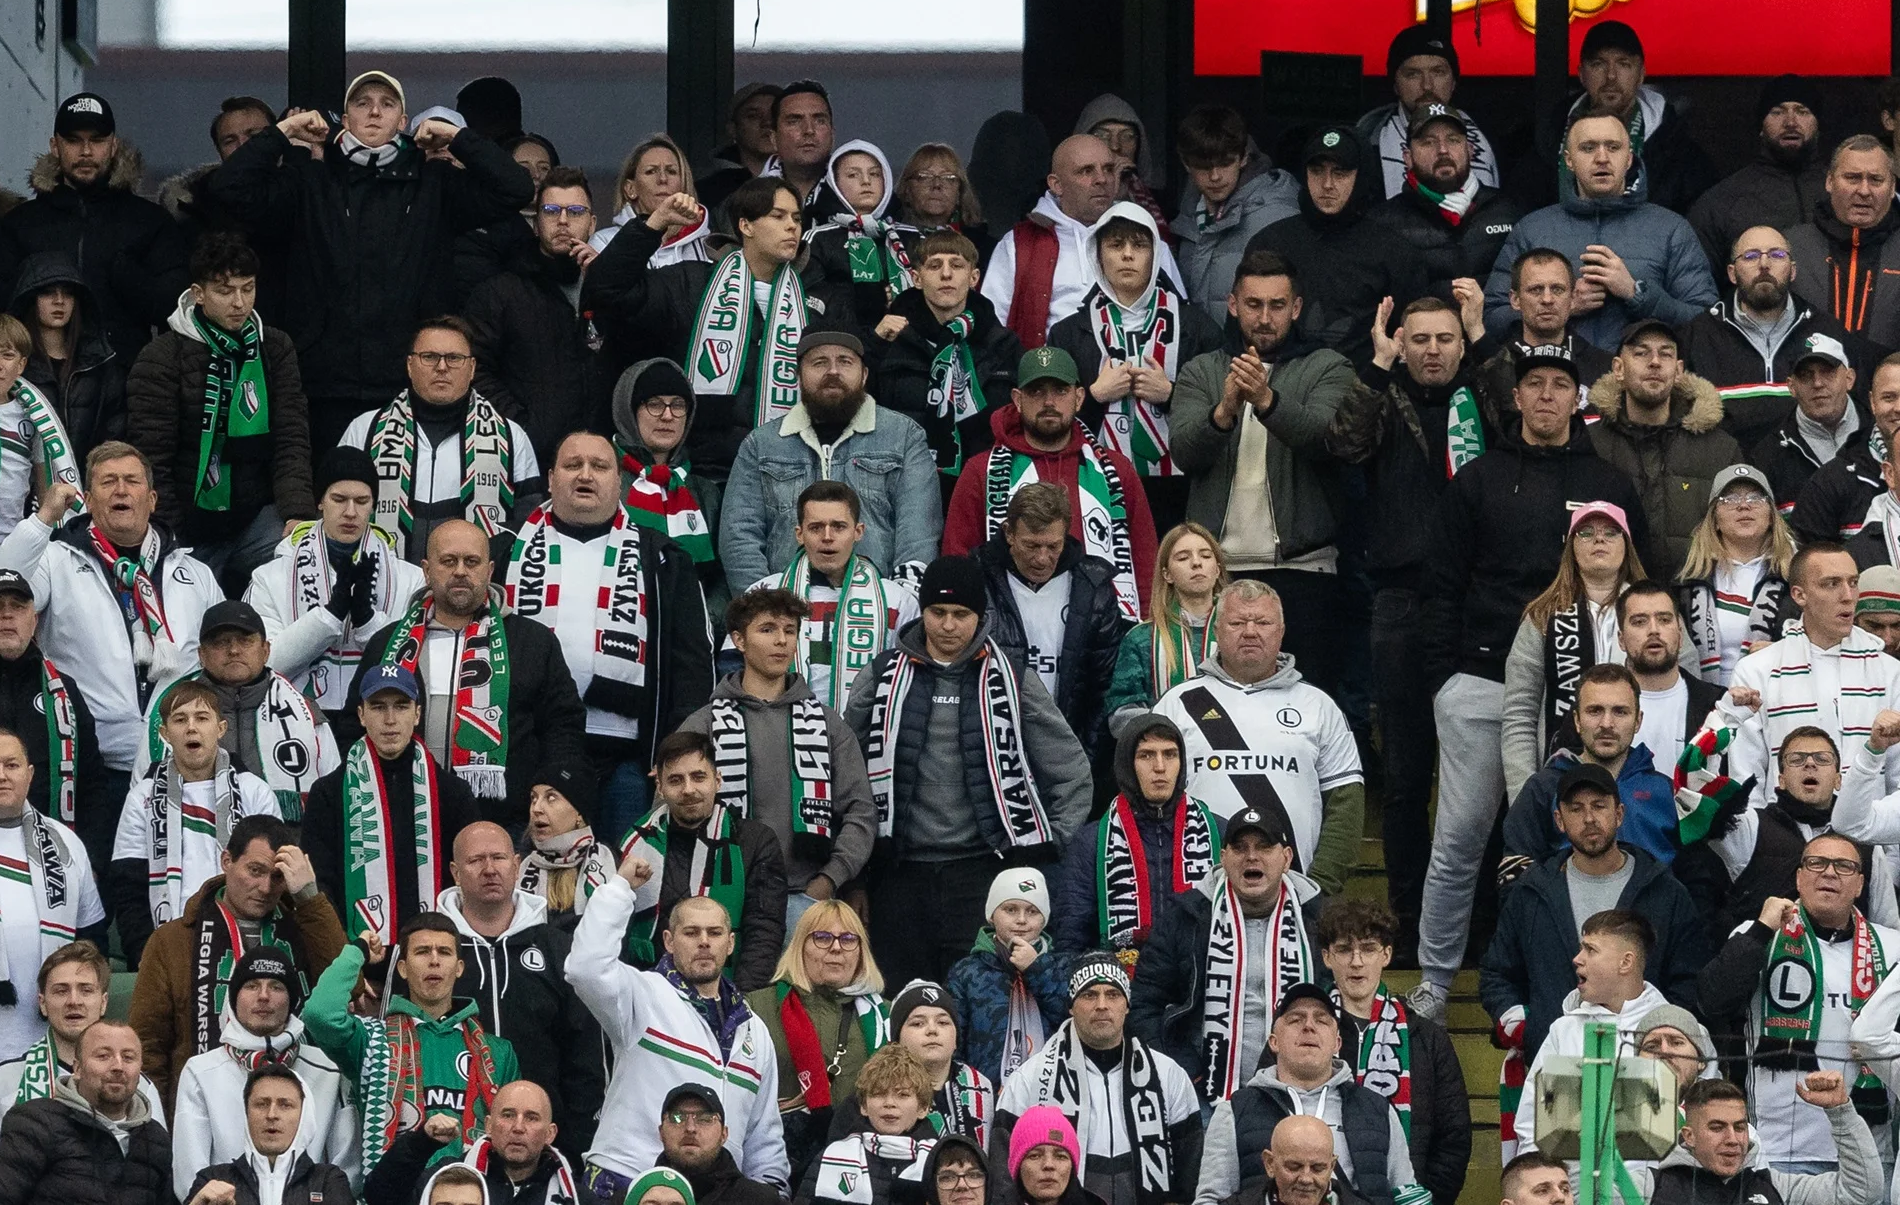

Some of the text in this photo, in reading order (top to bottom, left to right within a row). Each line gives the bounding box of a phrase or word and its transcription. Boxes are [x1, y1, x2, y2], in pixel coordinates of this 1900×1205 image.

[770, 321, 802, 410] EGIA
[476, 472, 498, 488] 1916
[1193, 754, 1300, 776] FORTUNA
[197, 919, 215, 1054] LEGIA WARSZ
[425, 1088, 467, 1111] NAL
